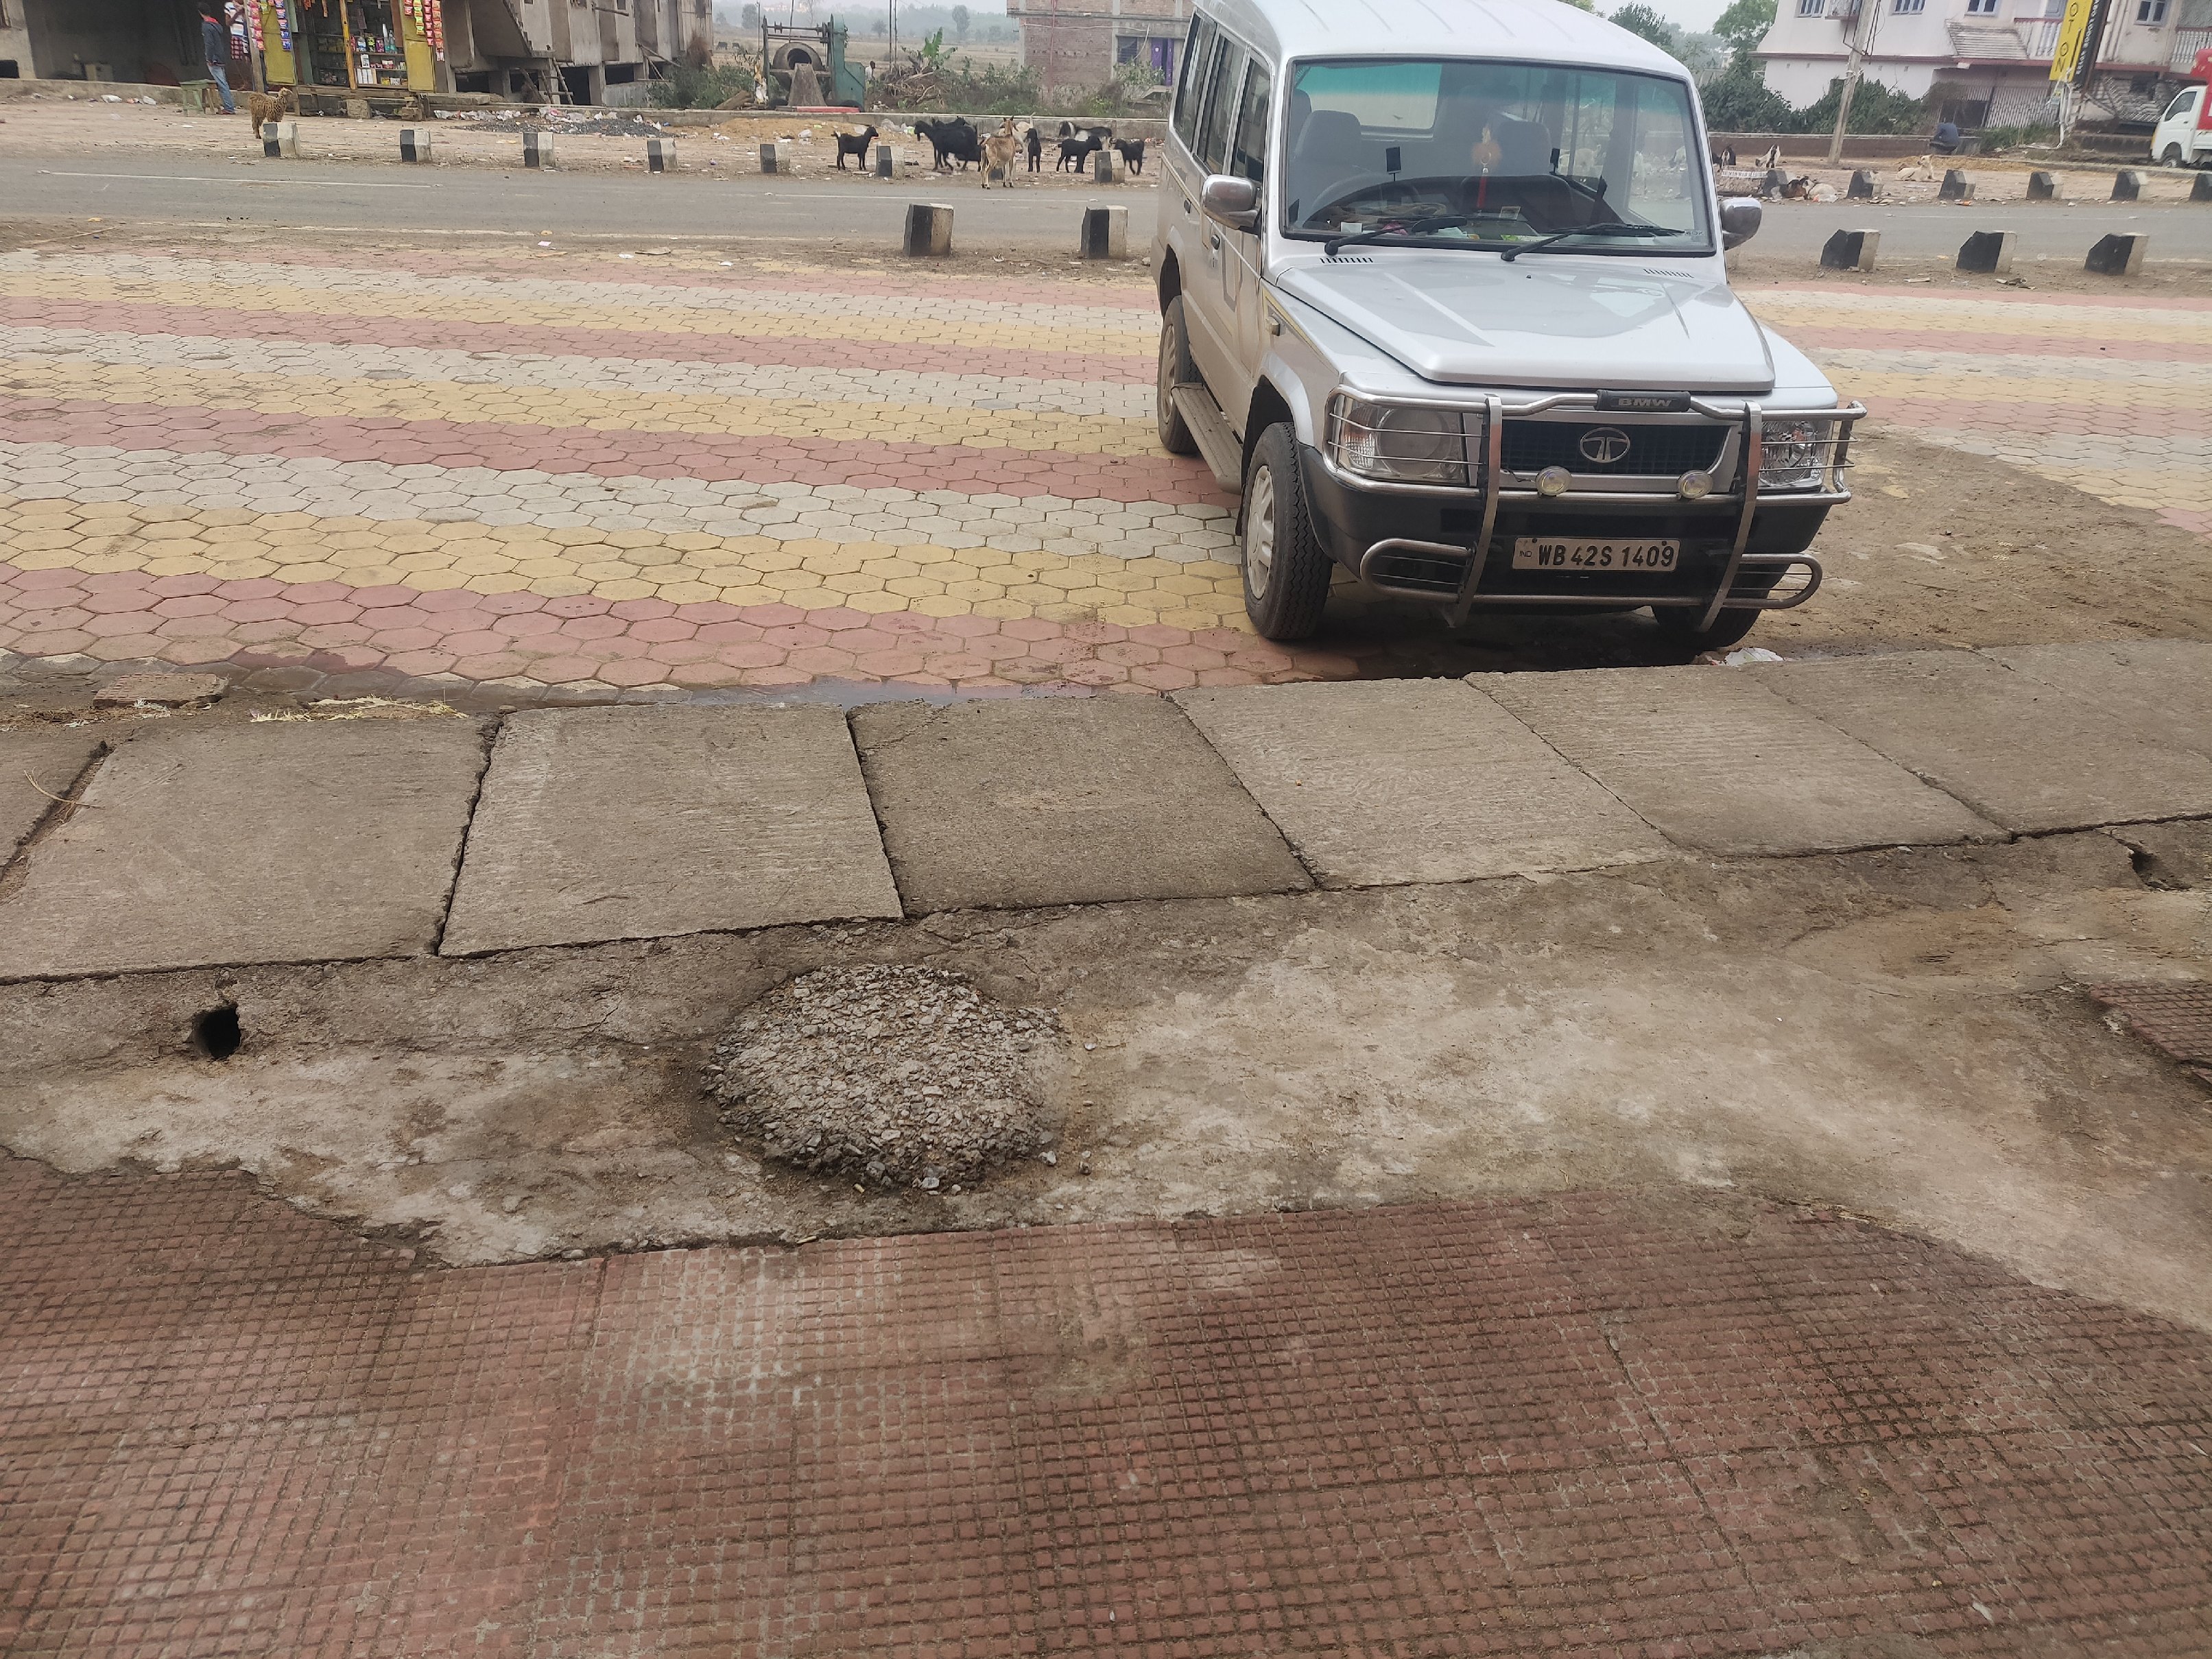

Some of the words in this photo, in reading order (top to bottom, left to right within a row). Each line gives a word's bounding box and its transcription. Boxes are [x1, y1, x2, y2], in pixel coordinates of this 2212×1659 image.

[1619, 398, 1672, 407] BMW
[1538, 545, 1566, 566] WB
[1571, 545, 1613, 566] 42S
[1621, 545, 1674, 566] 1409
